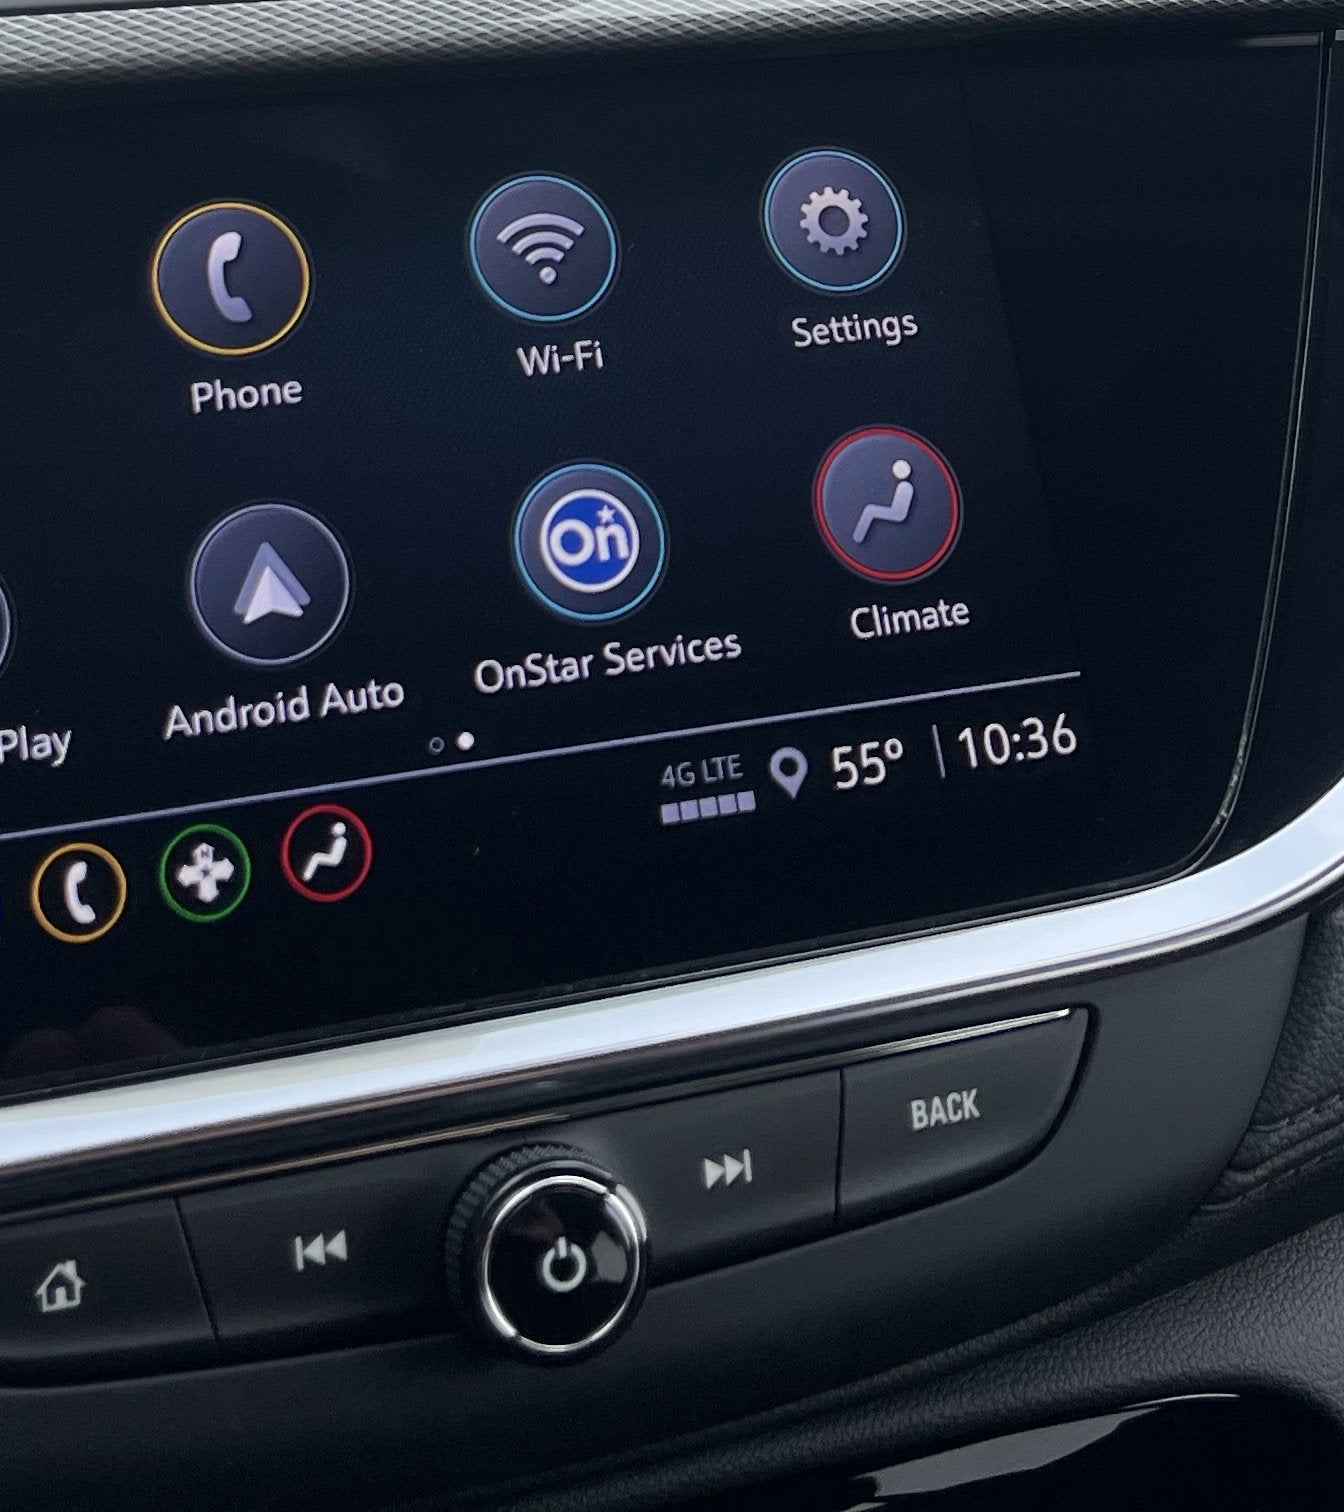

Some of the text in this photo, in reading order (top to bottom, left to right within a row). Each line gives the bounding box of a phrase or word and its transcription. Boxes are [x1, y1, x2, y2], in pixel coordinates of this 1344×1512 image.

[791, 310, 919, 350] Settings
[515, 338, 605, 377] Wi-Fi
[190, 377, 304, 414] Phone
[548, 514, 632, 568] On
[849, 597, 971, 641] Climate
[473, 631, 743, 695] OnStar Services
[162, 678, 406, 741] Android Auto
[831, 736, 905, 790] 55°
[957, 712, 1078, 771] 10:36
[659, 753, 745, 788] 4G LTE
[910, 1087, 982, 1131] BACK
